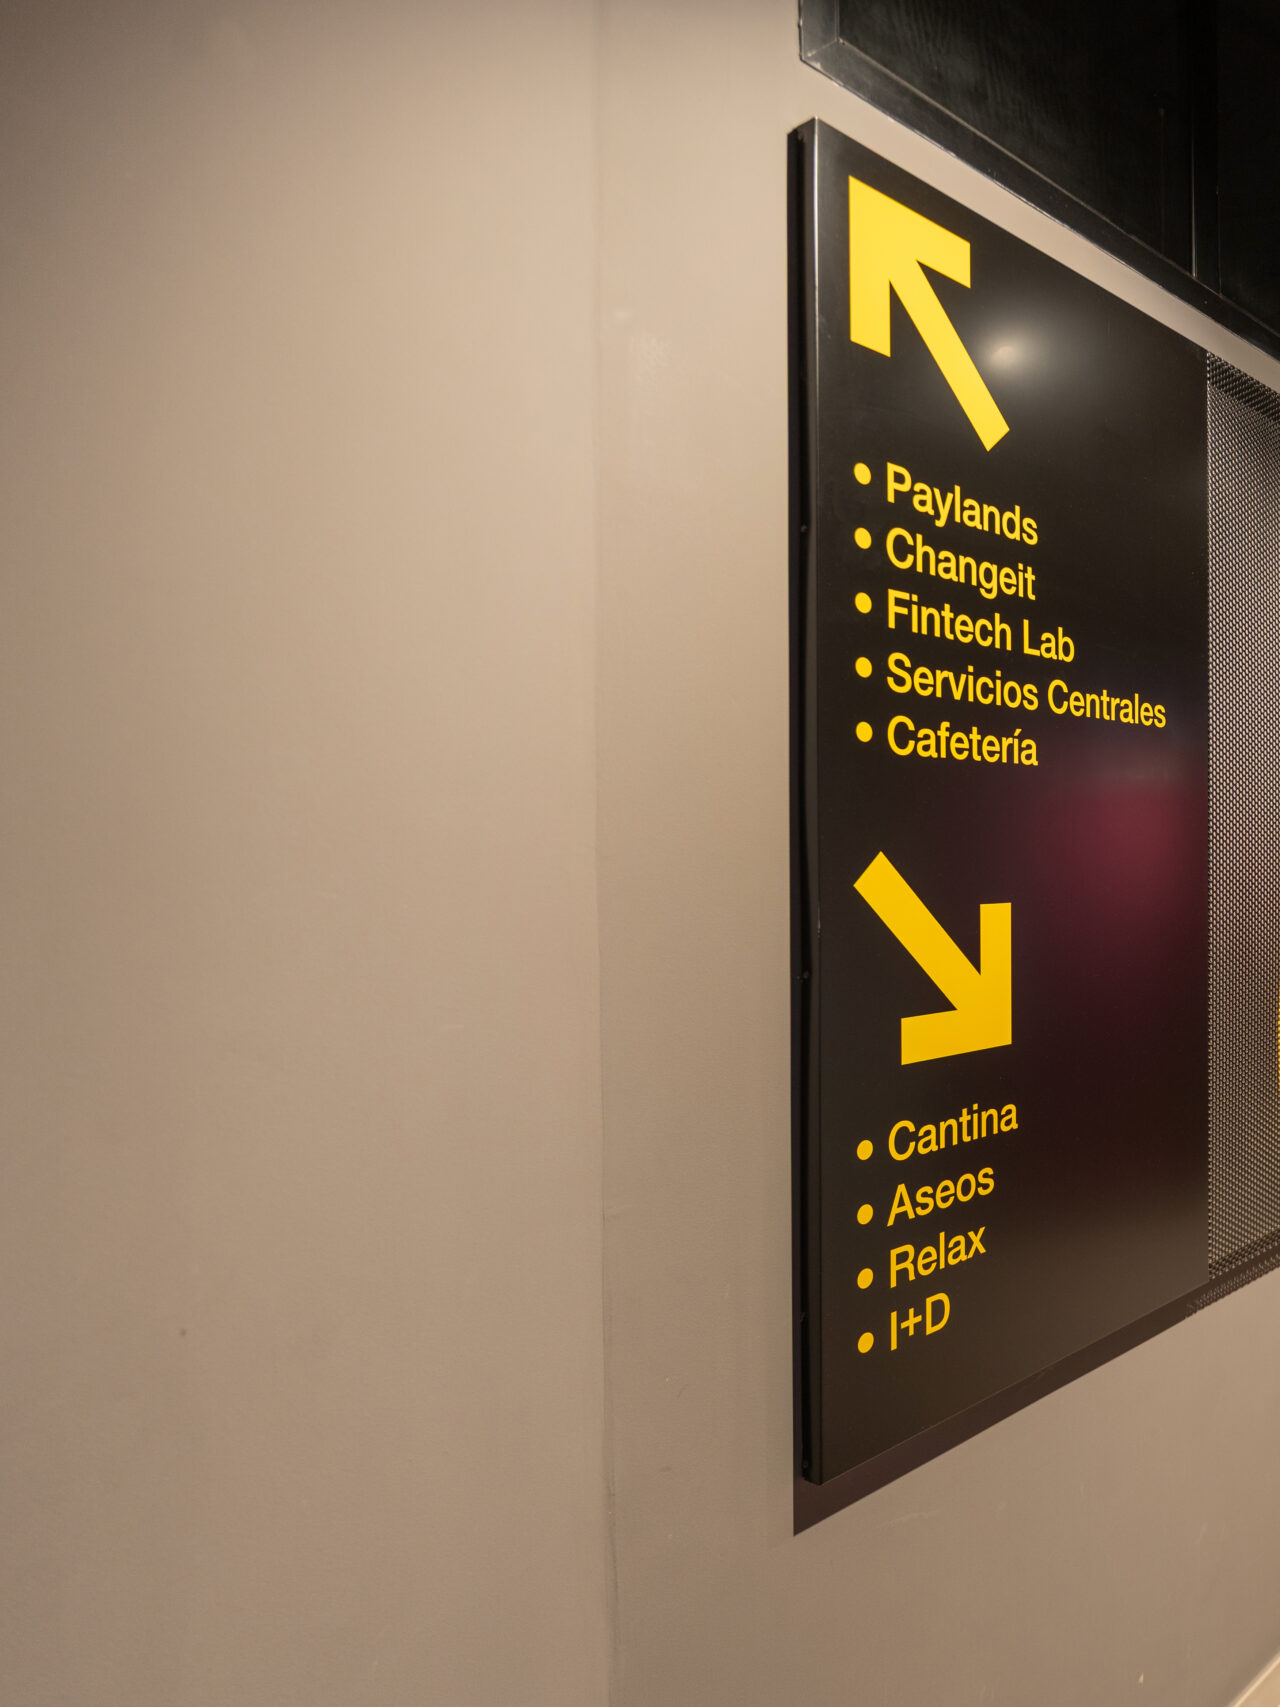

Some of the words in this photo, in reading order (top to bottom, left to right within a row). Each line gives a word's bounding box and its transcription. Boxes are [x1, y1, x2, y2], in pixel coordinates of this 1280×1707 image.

[886, 461, 1039, 546] Paylands
[885, 526, 1036, 601] Changeit
[887, 588, 1012, 652] Fintech
[1022, 618, 1075, 663] Lab
[886, 651, 1039, 711] Servicios
[1047, 678, 1167, 729] Centrales
[886, 714, 1039, 767] Cafetería
[887, 1103, 1019, 1162] Cantina
[886, 1166, 995, 1227] Aseos
[889, 1225, 987, 1289] Relax
[890, 1292, 951, 1352] I+D
